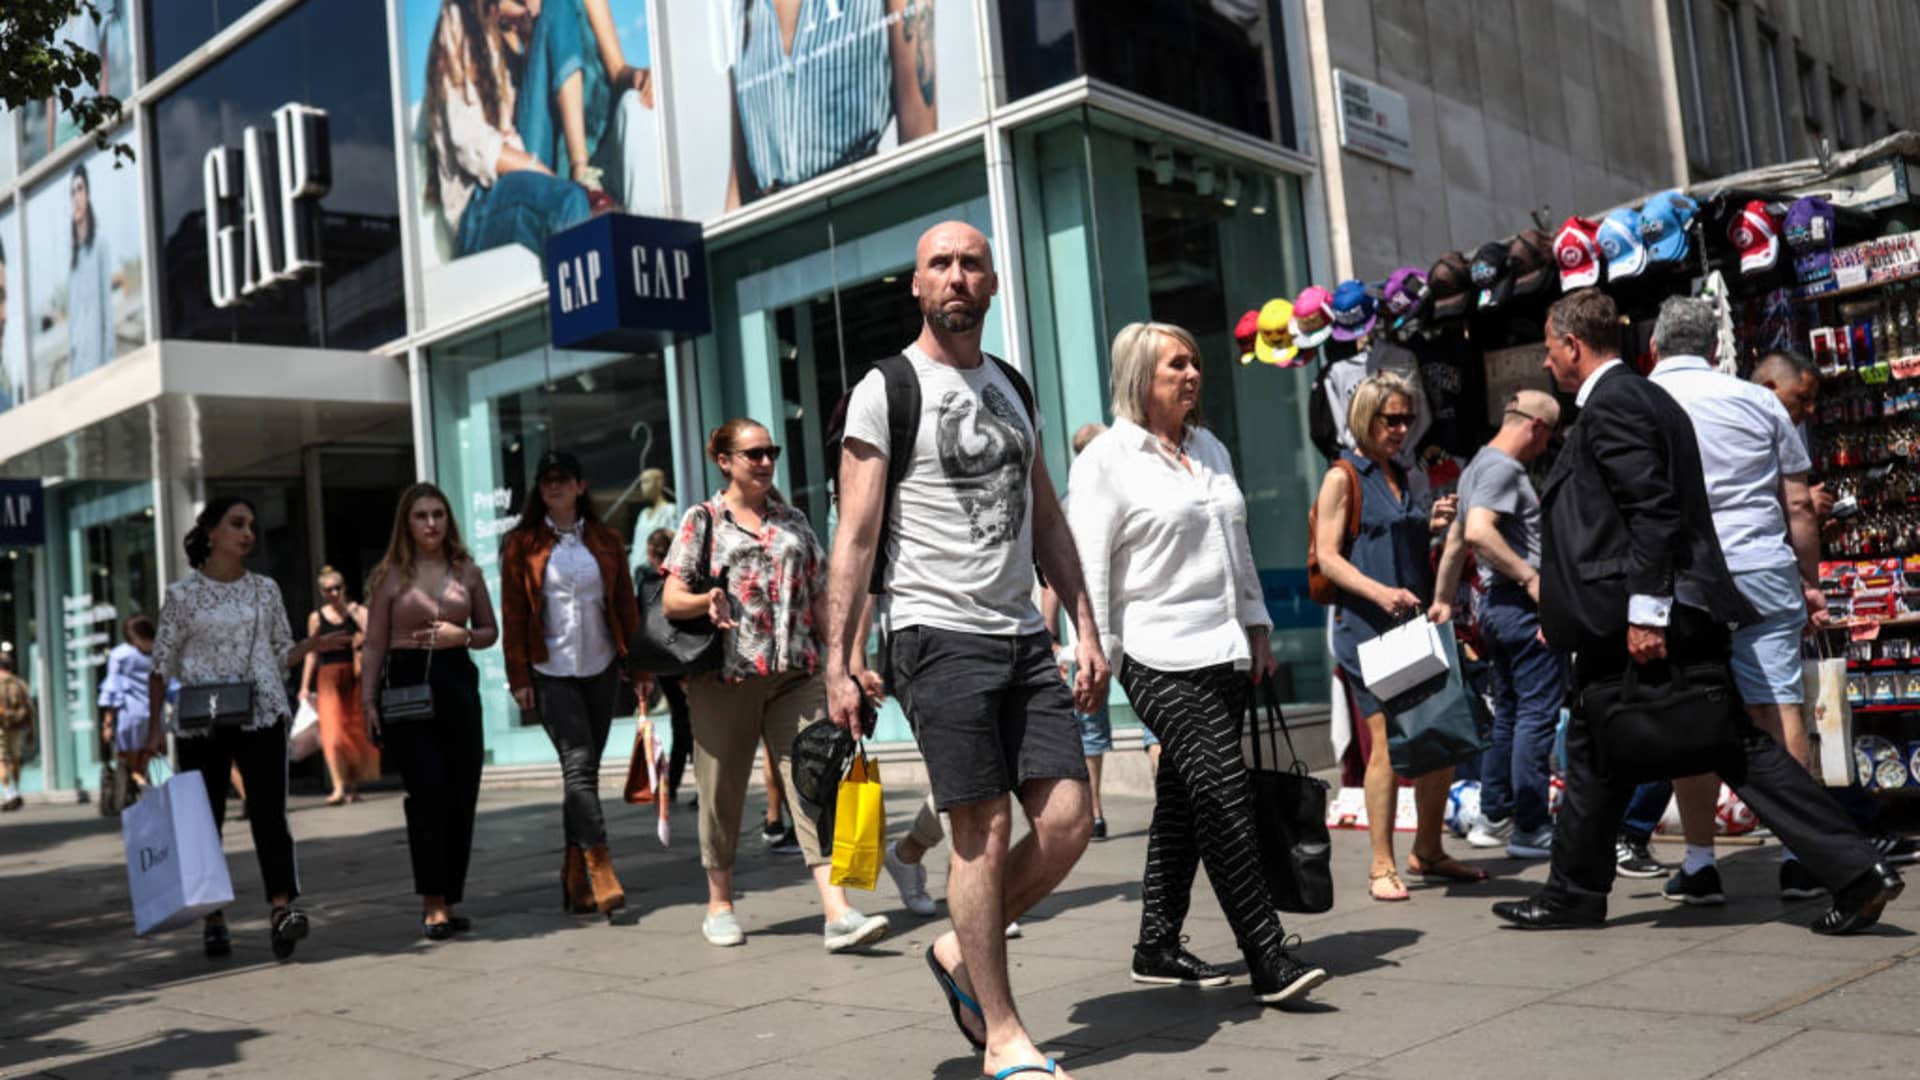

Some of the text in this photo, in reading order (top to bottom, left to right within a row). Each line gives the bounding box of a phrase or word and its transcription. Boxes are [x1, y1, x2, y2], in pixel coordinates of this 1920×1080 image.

[203, 101, 314, 309] GAP
[558, 249, 601, 314] GAP
[631, 244, 690, 300] GAP
[2, 495, 32, 527] AP
